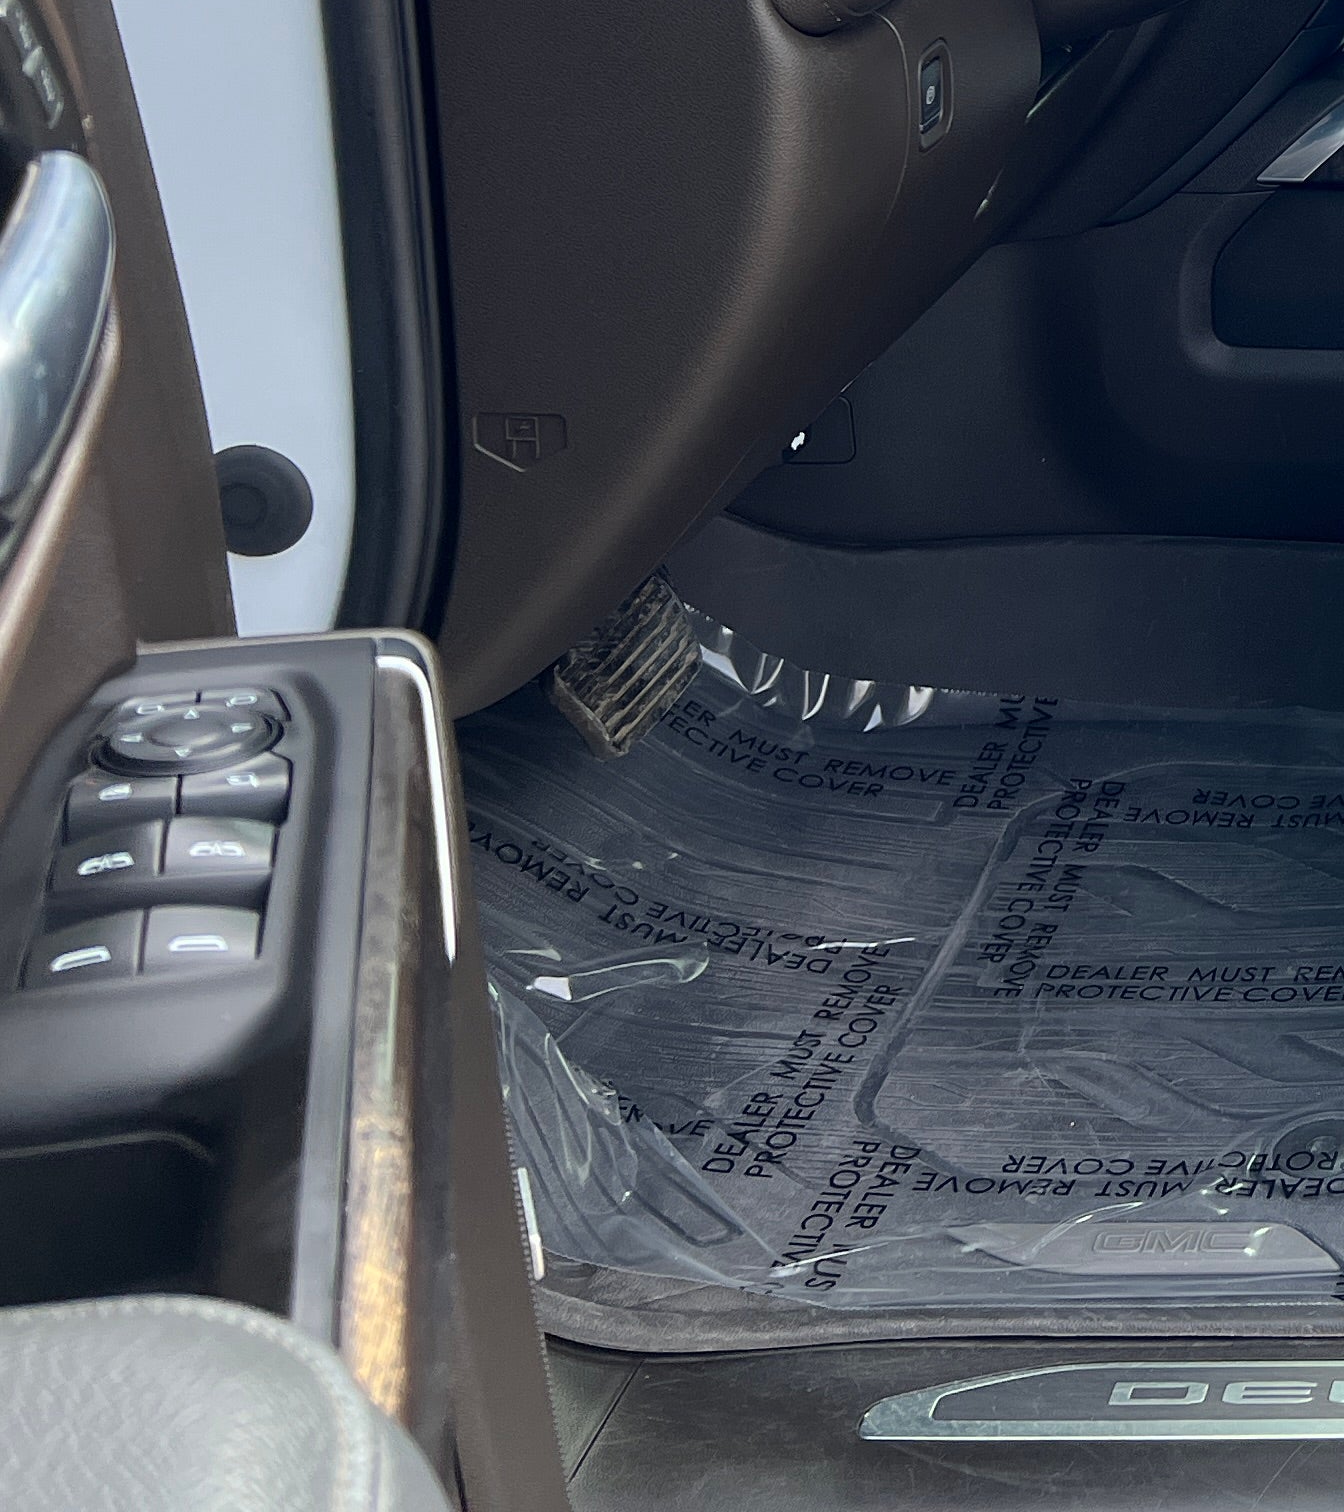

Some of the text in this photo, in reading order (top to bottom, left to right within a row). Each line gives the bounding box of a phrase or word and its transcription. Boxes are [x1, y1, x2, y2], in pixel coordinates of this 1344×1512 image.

[729, 728, 957, 786] MUST REMOVE
[987, 696, 1059, 810] PROTECTIVE
[773, 768, 885, 798] COVER
[952, 742, 1008, 808] DEALER
[1122, 806, 1254, 829] REMOVE
[1191, 788, 1301, 809] COVER
[469, 822, 590, 903] REMOV
[976, 778, 1093, 963] PROTECTIVE COVER
[993, 781, 1127, 998] DEALER MUST REMOVE
[600, 903, 689, 944] MUST
[1033, 982, 1235, 1002] PROTECTIVE
[1045, 965, 1169, 981] DEALER
[1187, 966, 1277, 983] MUST
[701, 945, 891, 1174] DEALER MUST REMOVE
[744, 983, 904, 1179] PROTECTIVE COVER
[914, 1171, 1080, 1196] REMOVE
[1002, 1153, 1135, 1176] COVER
[845, 1144, 922, 1229] DEALER
[1095, 1178, 1195, 1198] MUST
[1092, 1229, 1255, 1254] GMC
